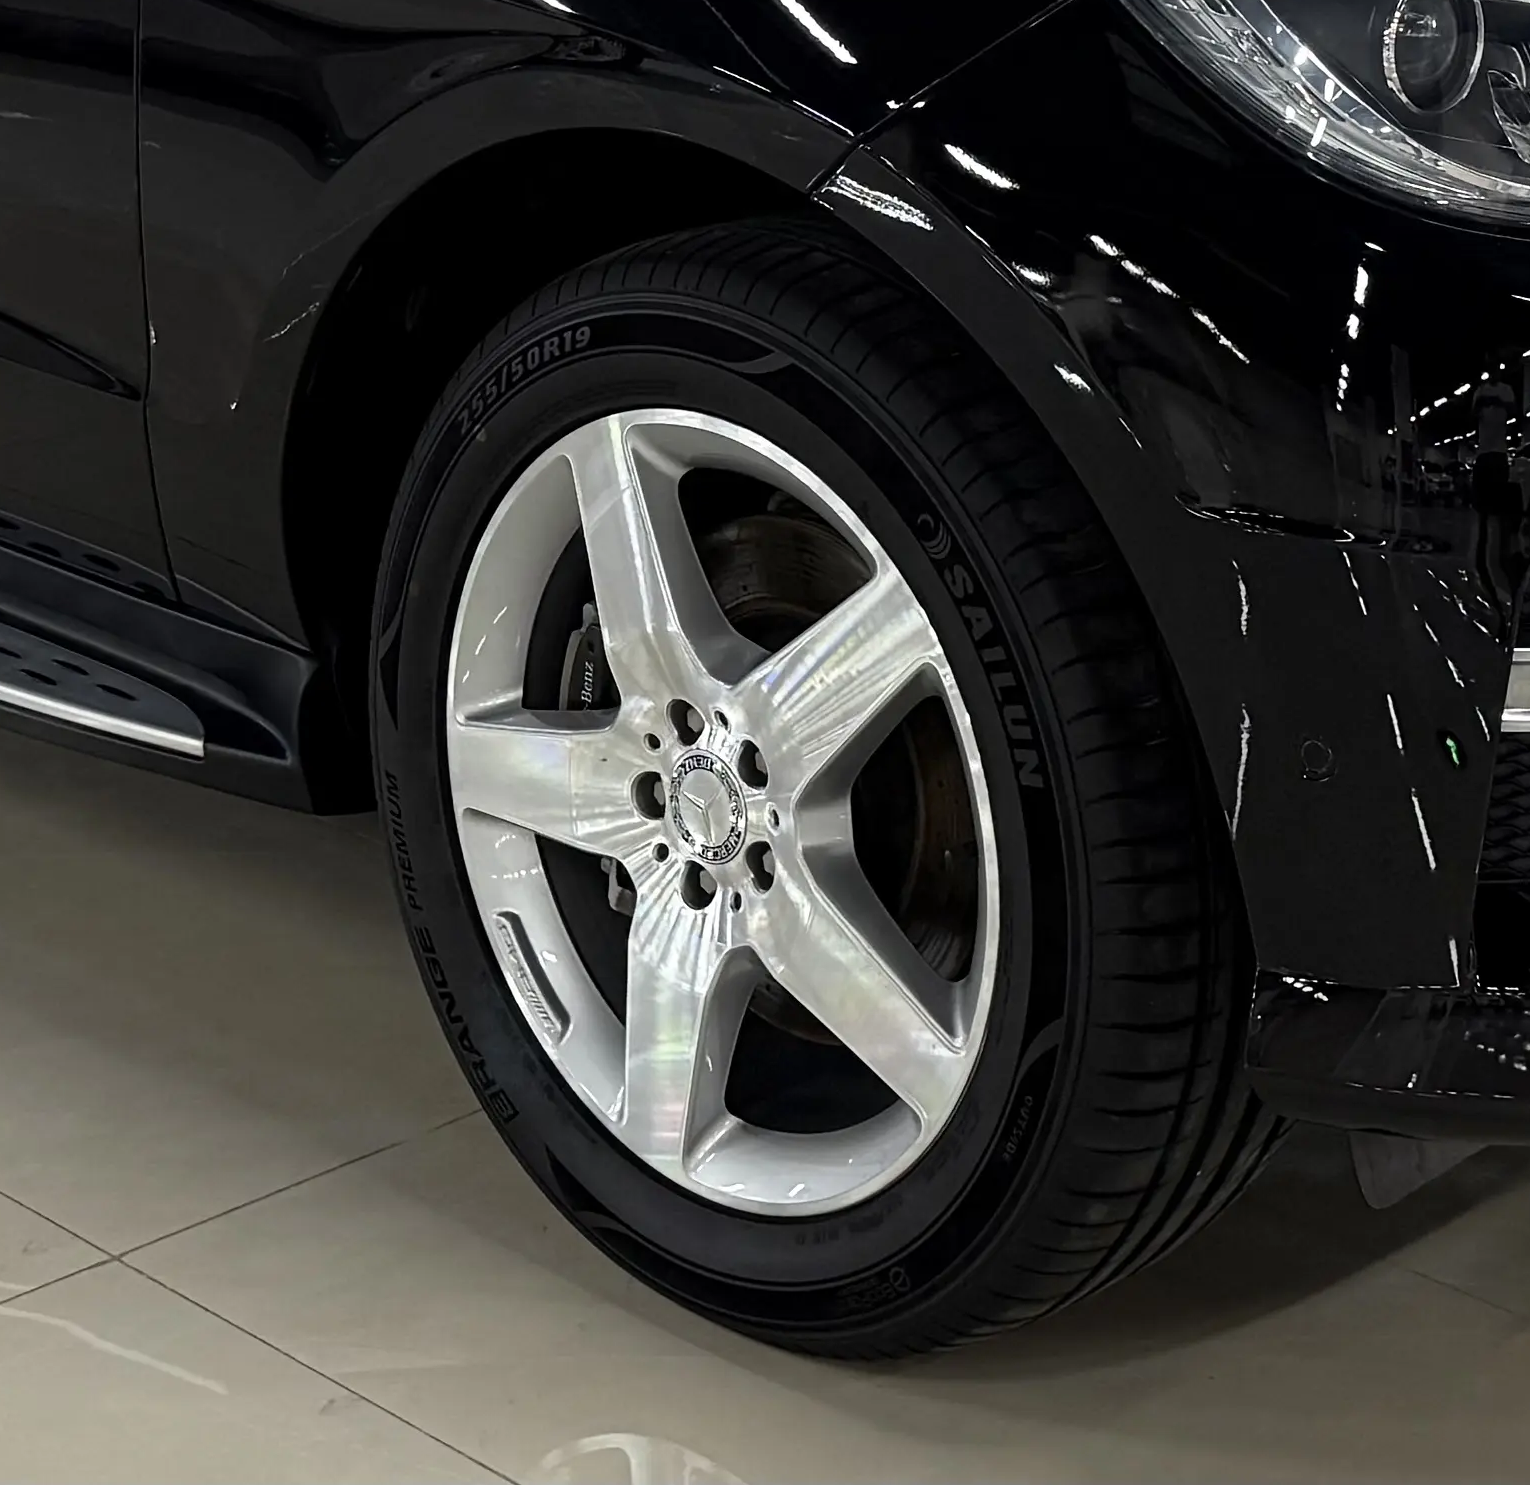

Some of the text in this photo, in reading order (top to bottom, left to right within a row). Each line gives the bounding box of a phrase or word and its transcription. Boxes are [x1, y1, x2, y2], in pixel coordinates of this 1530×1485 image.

[456, 325, 592, 437] 255/50R19
[942, 563, 1045, 789] SAILUN
[383, 771, 424, 911] PREMIUM
